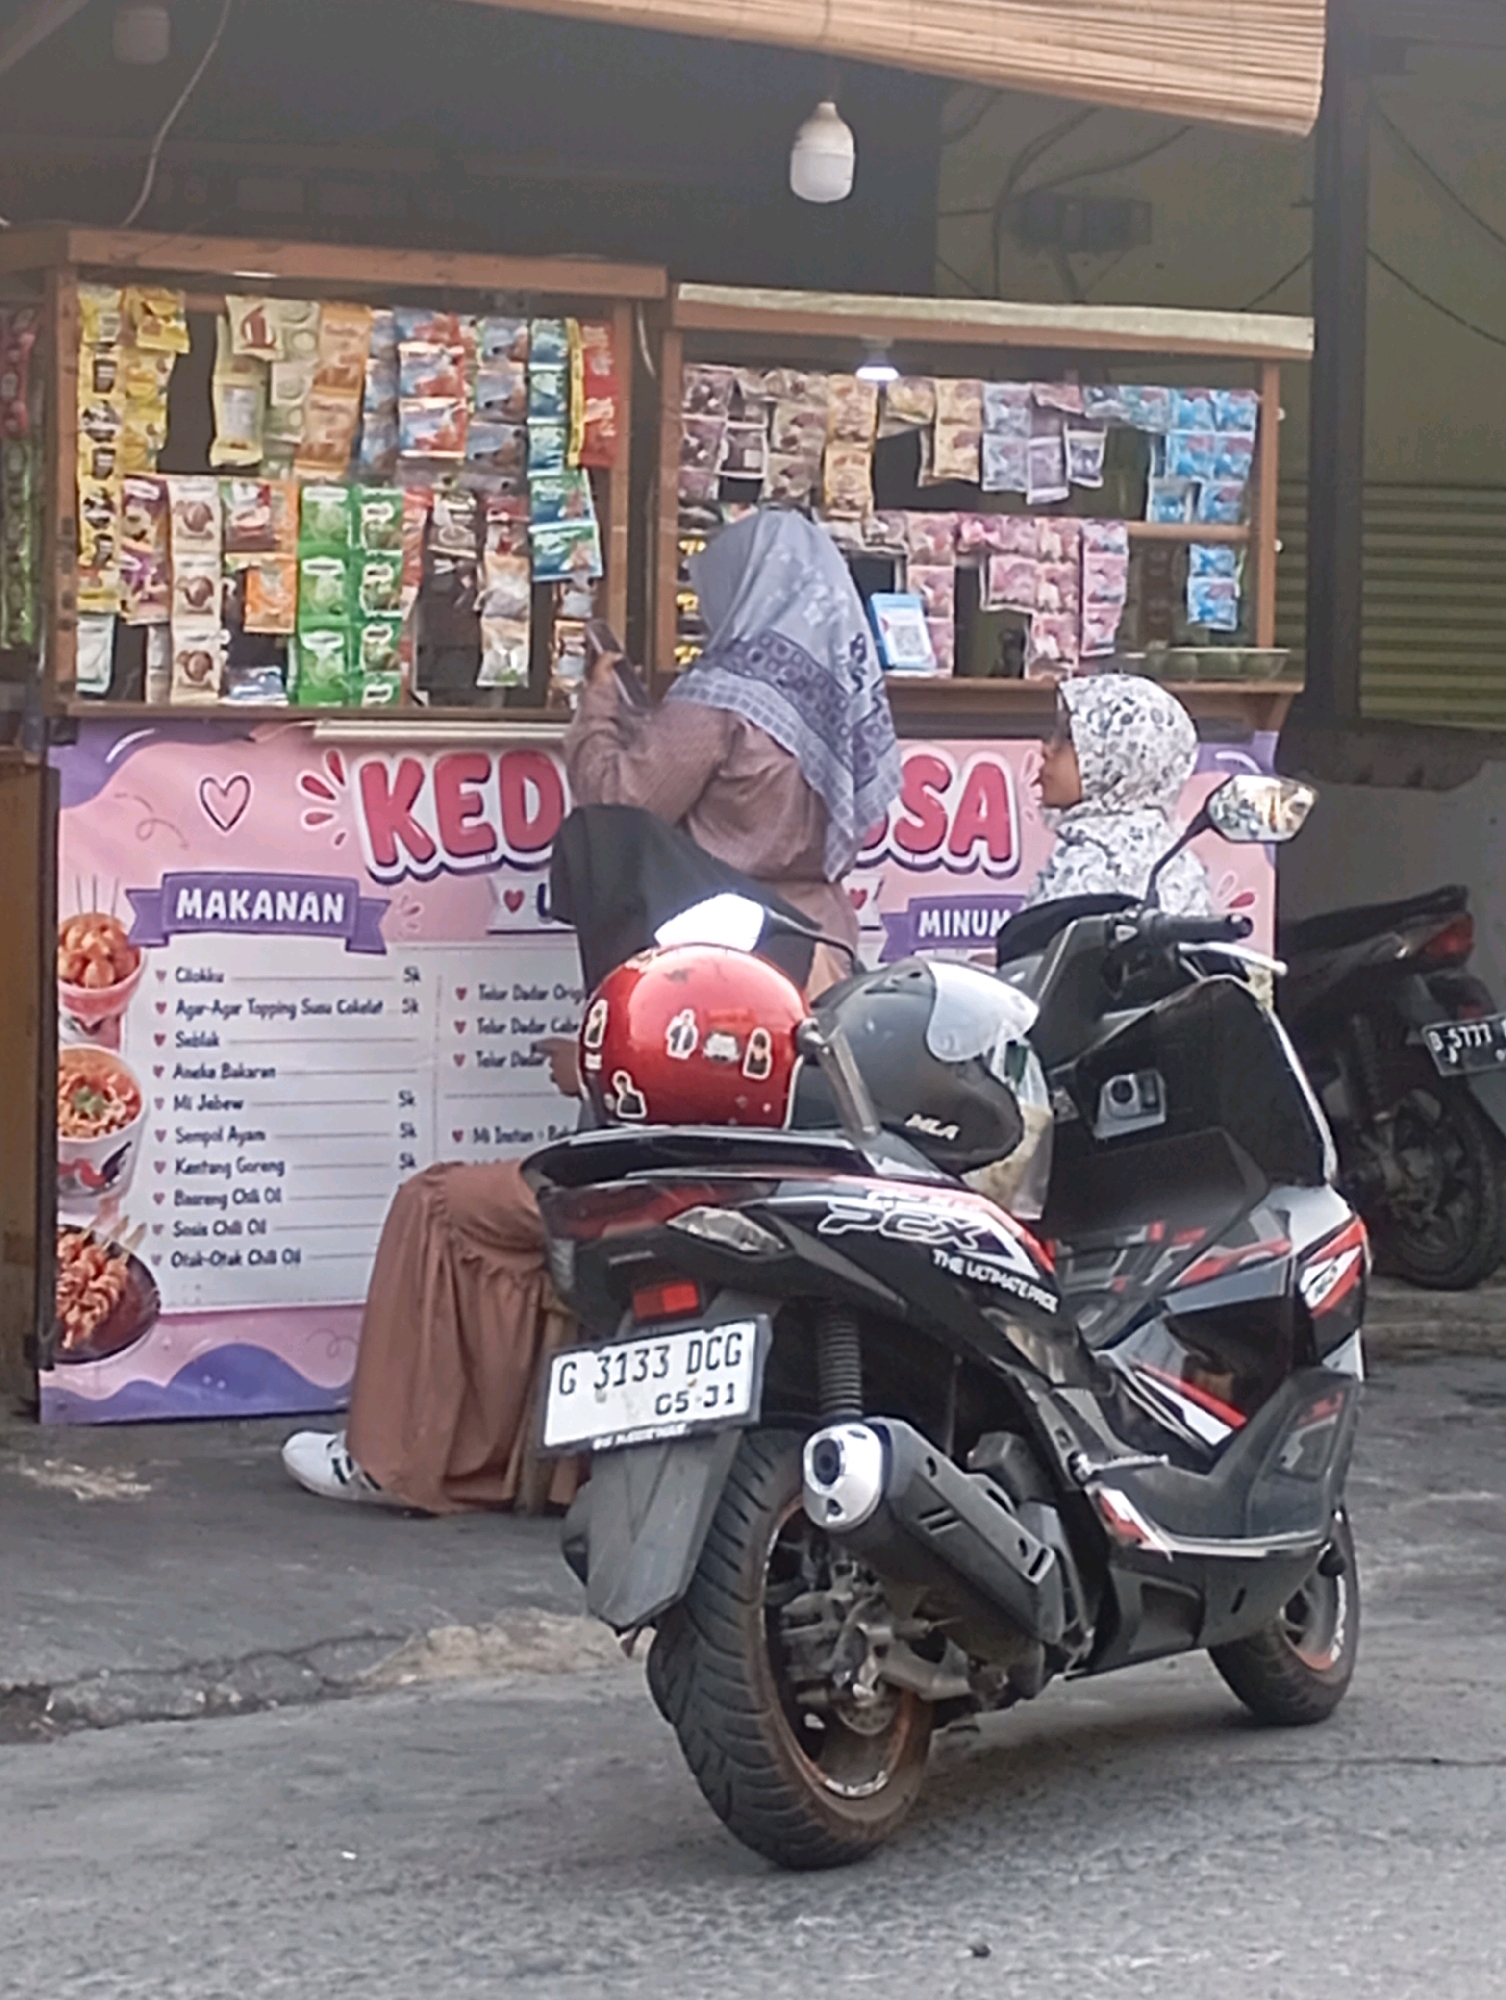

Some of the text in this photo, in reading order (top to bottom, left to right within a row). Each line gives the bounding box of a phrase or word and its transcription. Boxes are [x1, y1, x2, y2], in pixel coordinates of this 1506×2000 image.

[358, 747, 1013, 868] KED SA
[176, 888, 344, 923] MAKANAN
[479, 983, 508, 1001] Telur
[513, 983, 549, 1001] Dadar
[176, 998, 243, 1021] Agar-Agar
[246, 997, 297, 1020] Topping
[301, 998, 332, 1015] Susu
[336, 998, 384, 1015] Cokelat
[477, 1016, 507, 1034] Telur
[511, 1016, 546, 1034] Dadar
[175, 1030, 220, 1048] Seblak
[476, 1049, 507, 1068] Telur
[173, 1061, 276, 1079] Aneka Bakaran
[174, 1094, 192, 1111] Mi
[197, 1093, 244, 1111] Jebew
[175, 1126, 223, 1148] Sempol
[226, 1125, 266, 1148] Ayam
[175, 1156, 231, 1180] Kentang
[235, 1155, 285, 1177] Goreng
[817, 1199, 986, 1251] PCX
[171, 1249, 242, 1268] Otak-Otak
[558, 1331, 743, 1396] G 3133 DCG
